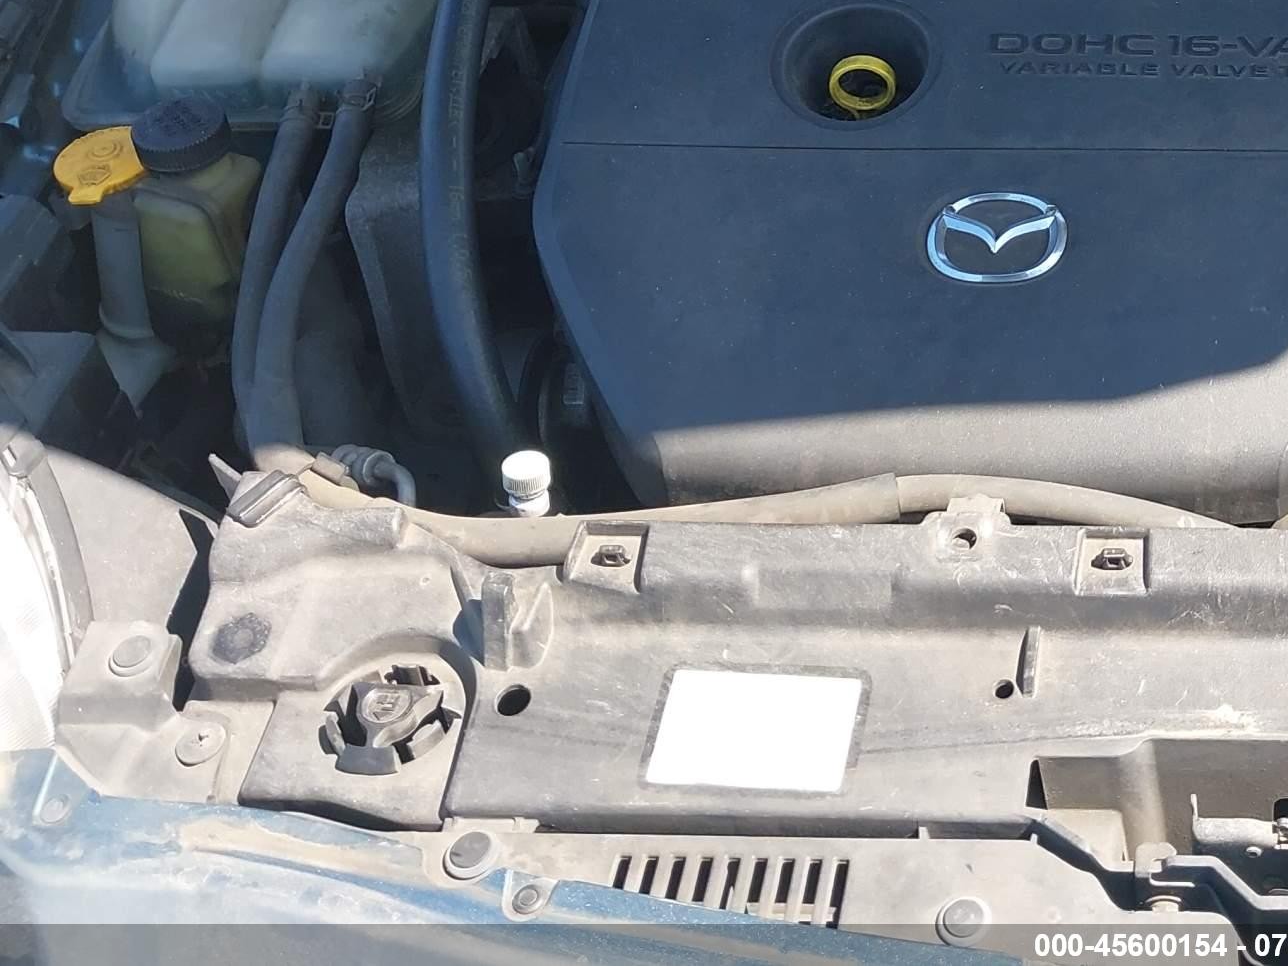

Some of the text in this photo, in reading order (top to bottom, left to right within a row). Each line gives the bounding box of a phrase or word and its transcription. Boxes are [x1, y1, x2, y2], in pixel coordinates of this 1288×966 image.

[989, 32, 1158, 57] DOHC
[1000, 60, 1160, 77] VARIABLE
[1171, 61, 1270, 78] VALVE
